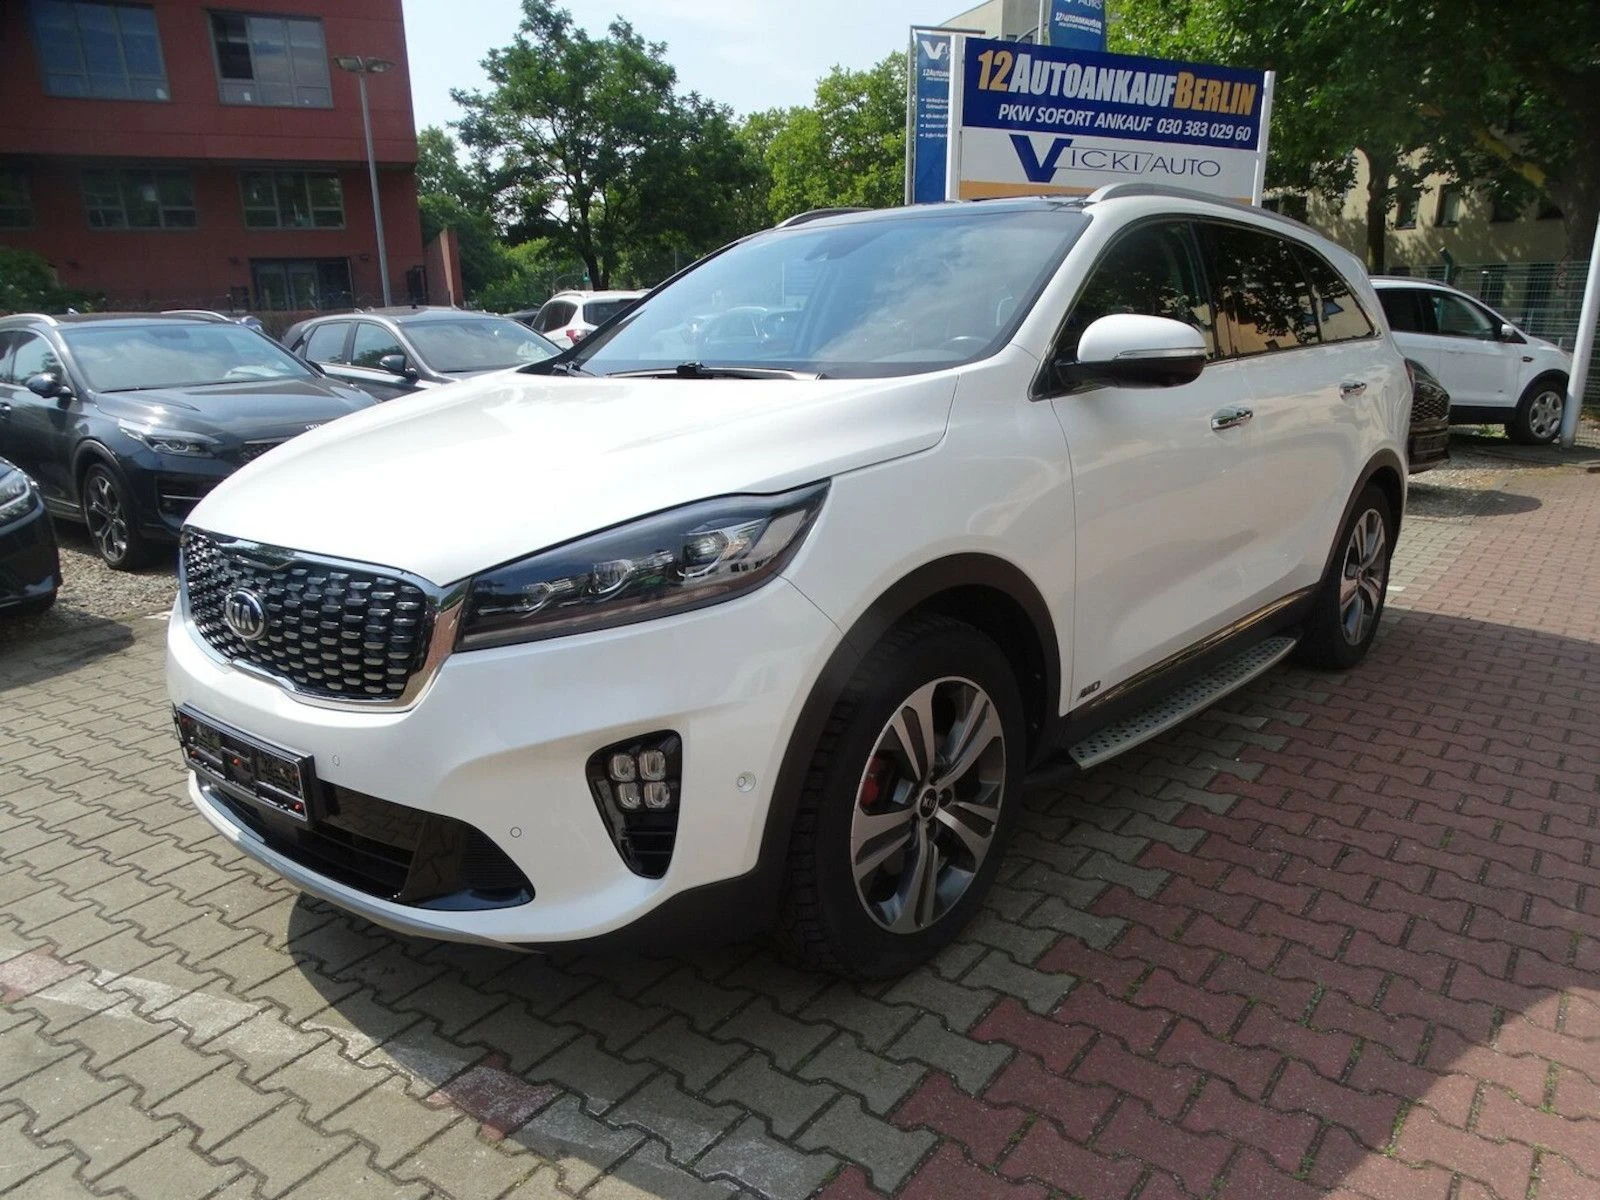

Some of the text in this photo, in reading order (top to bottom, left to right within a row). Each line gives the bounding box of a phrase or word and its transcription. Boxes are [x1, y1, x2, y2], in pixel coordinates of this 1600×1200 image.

[998, 103, 1252, 142] PKW SOFORT ANKAUF 030 383 029 60
